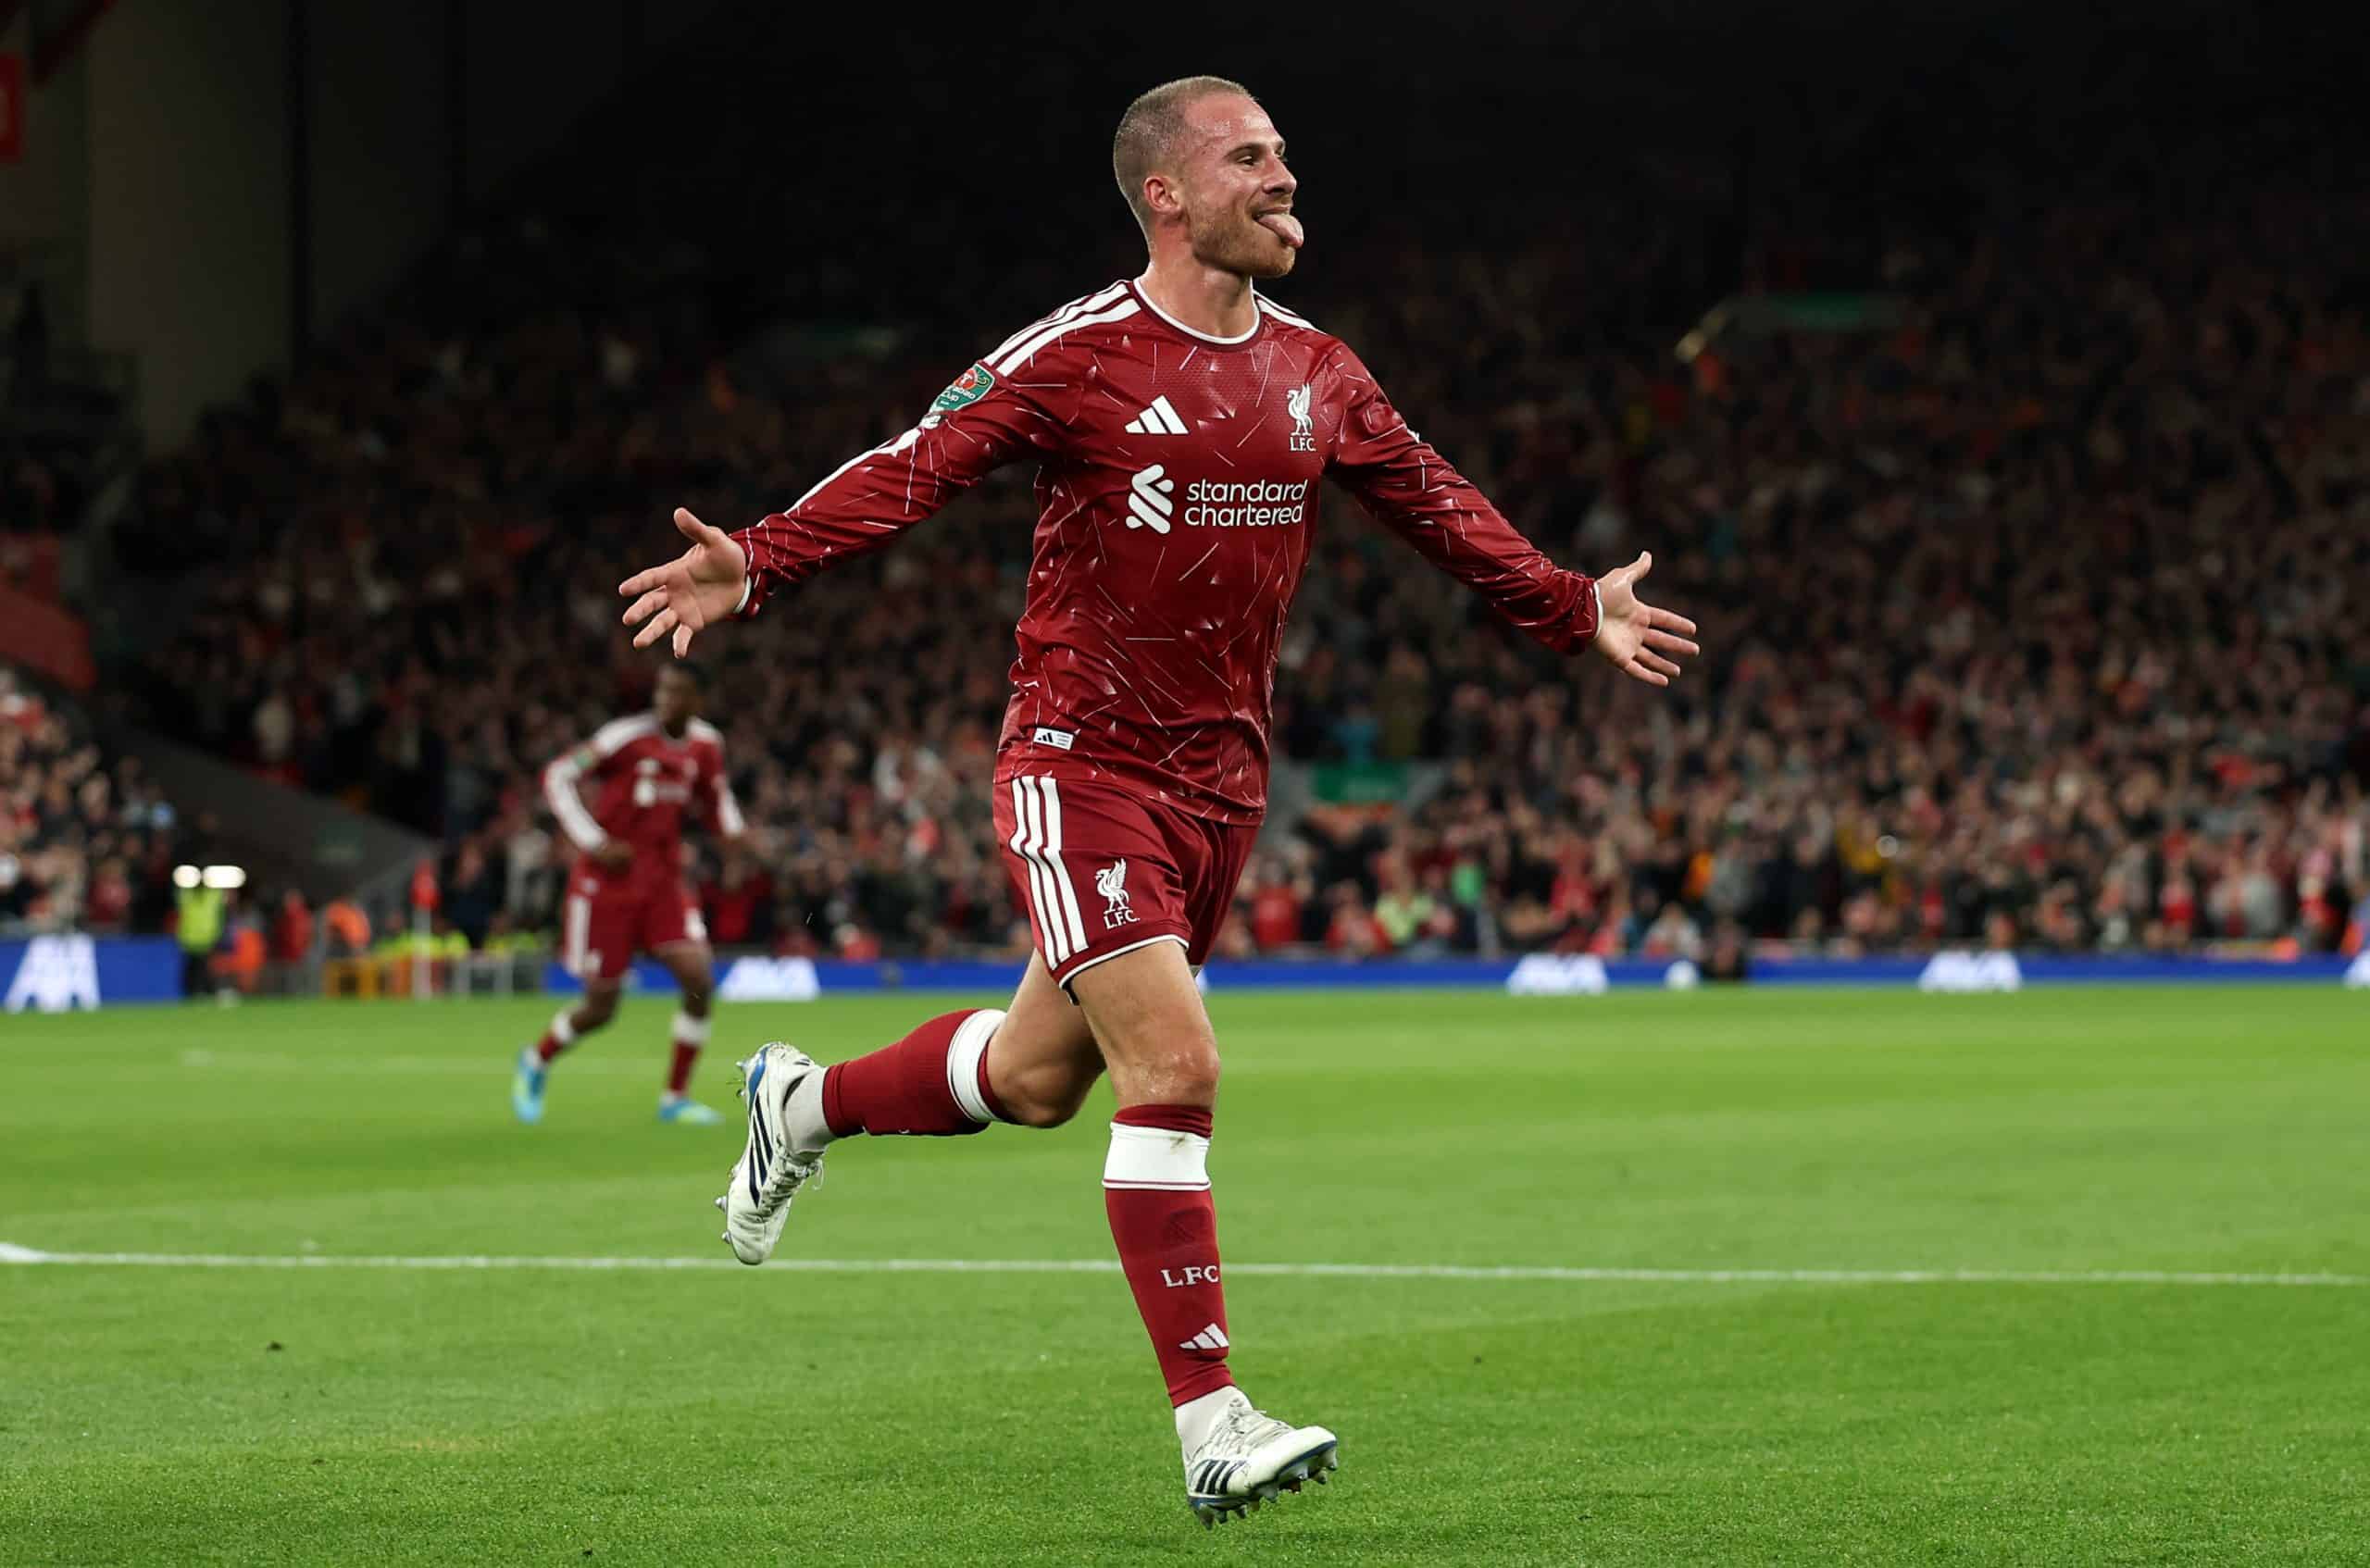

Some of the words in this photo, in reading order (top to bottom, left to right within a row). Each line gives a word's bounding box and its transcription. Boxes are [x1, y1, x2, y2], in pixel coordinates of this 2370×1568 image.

[1186, 479, 1308, 503] standard
[1184, 501, 1305, 527] chartered
[1160, 1264, 1219, 1288] LFC
